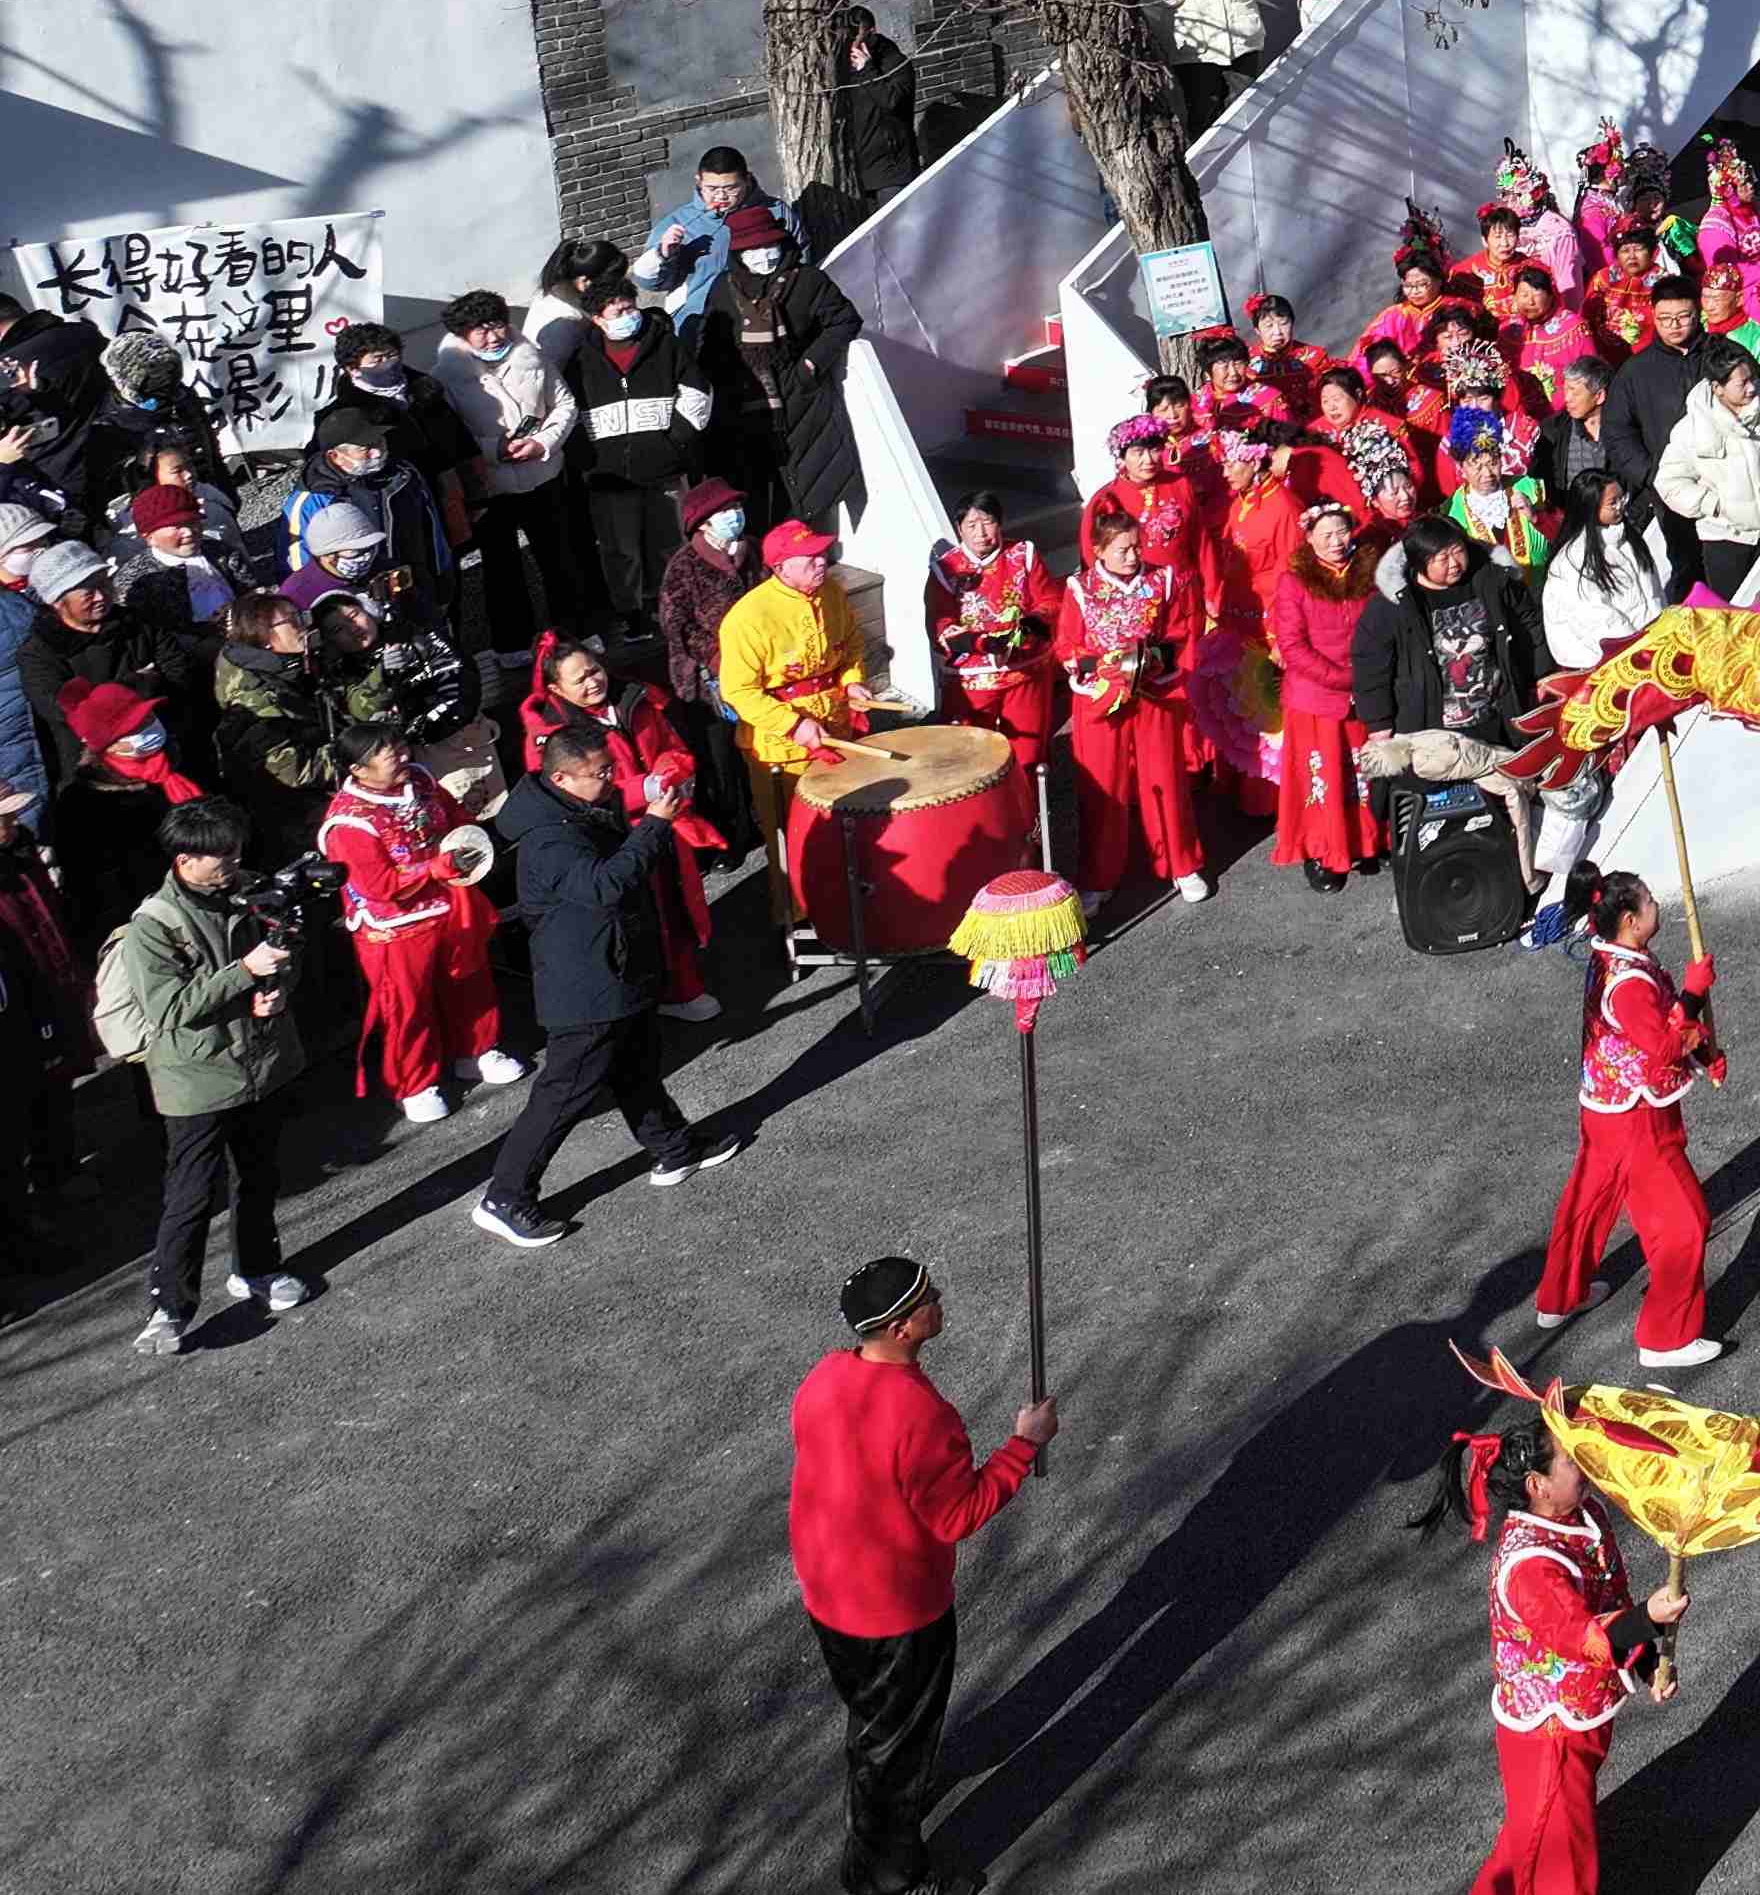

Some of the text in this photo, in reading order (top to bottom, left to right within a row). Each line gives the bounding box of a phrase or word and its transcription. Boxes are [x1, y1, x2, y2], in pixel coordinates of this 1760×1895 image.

[37, 223, 367, 314] 长得好看的人
